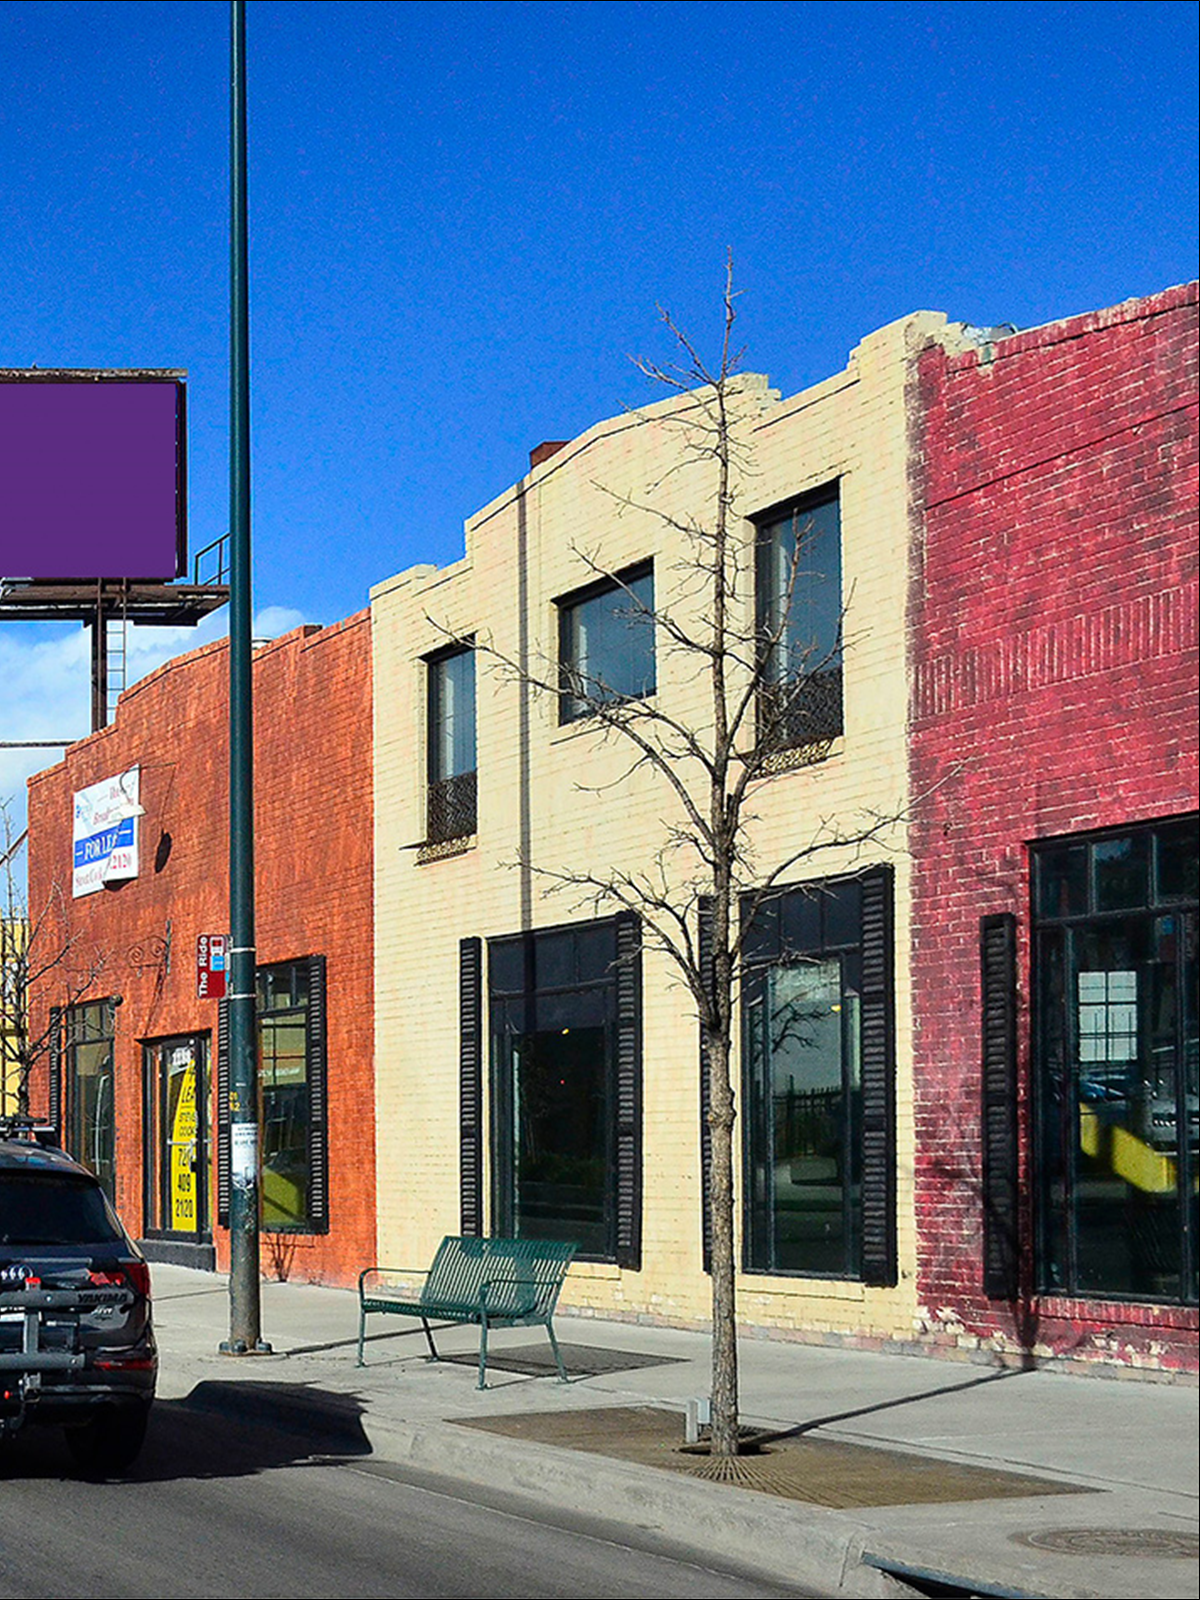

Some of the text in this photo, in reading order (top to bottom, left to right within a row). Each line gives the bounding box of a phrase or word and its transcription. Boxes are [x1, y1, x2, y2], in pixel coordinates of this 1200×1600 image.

[199, 936, 209, 997] The Ride
[176, 1199, 193, 1217] 2120
[78, 1294, 127, 1304] YAKIMA
